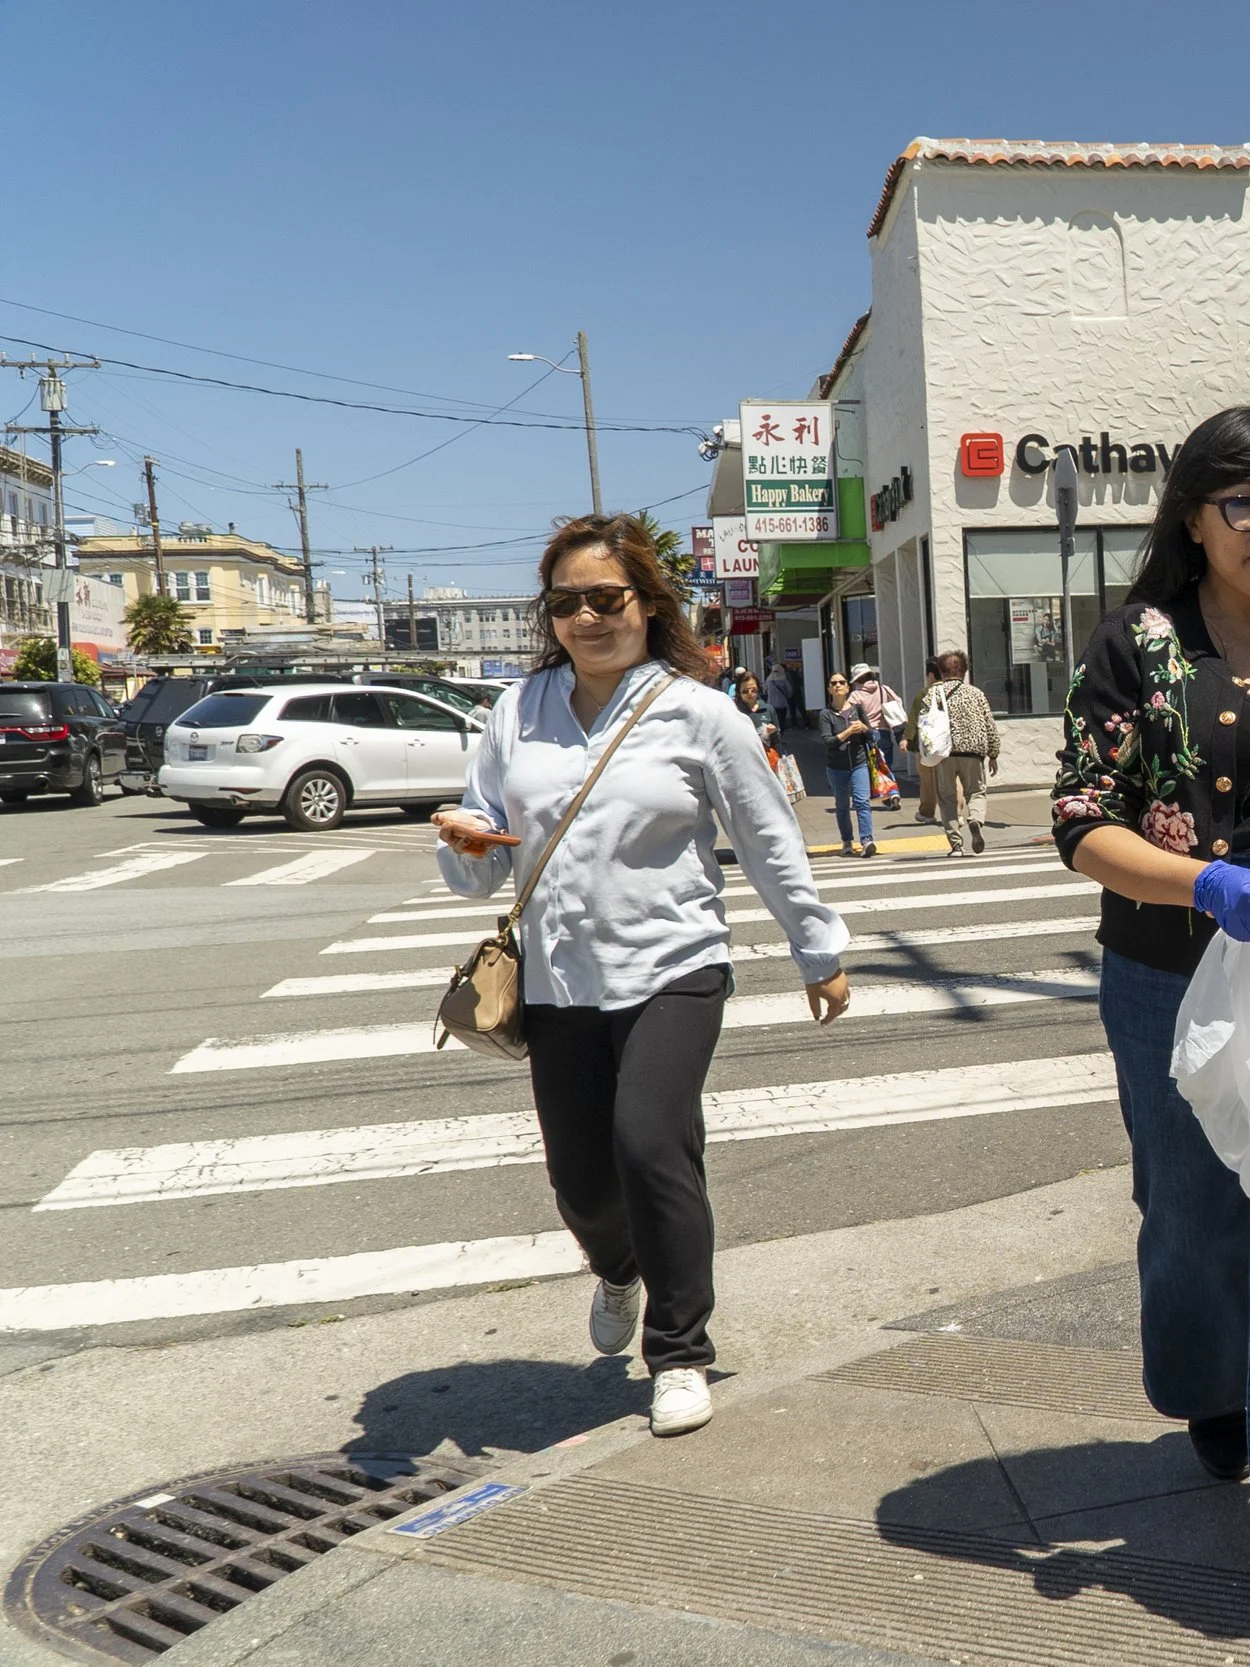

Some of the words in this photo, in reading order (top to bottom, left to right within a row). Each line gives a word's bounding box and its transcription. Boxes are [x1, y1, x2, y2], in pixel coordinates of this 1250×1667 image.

[752, 414, 819, 447] 永利
[751, 484, 788, 507] Happy
[790, 484, 829, 506] Bakery
[755, 516, 829, 533] 415-661-1386
